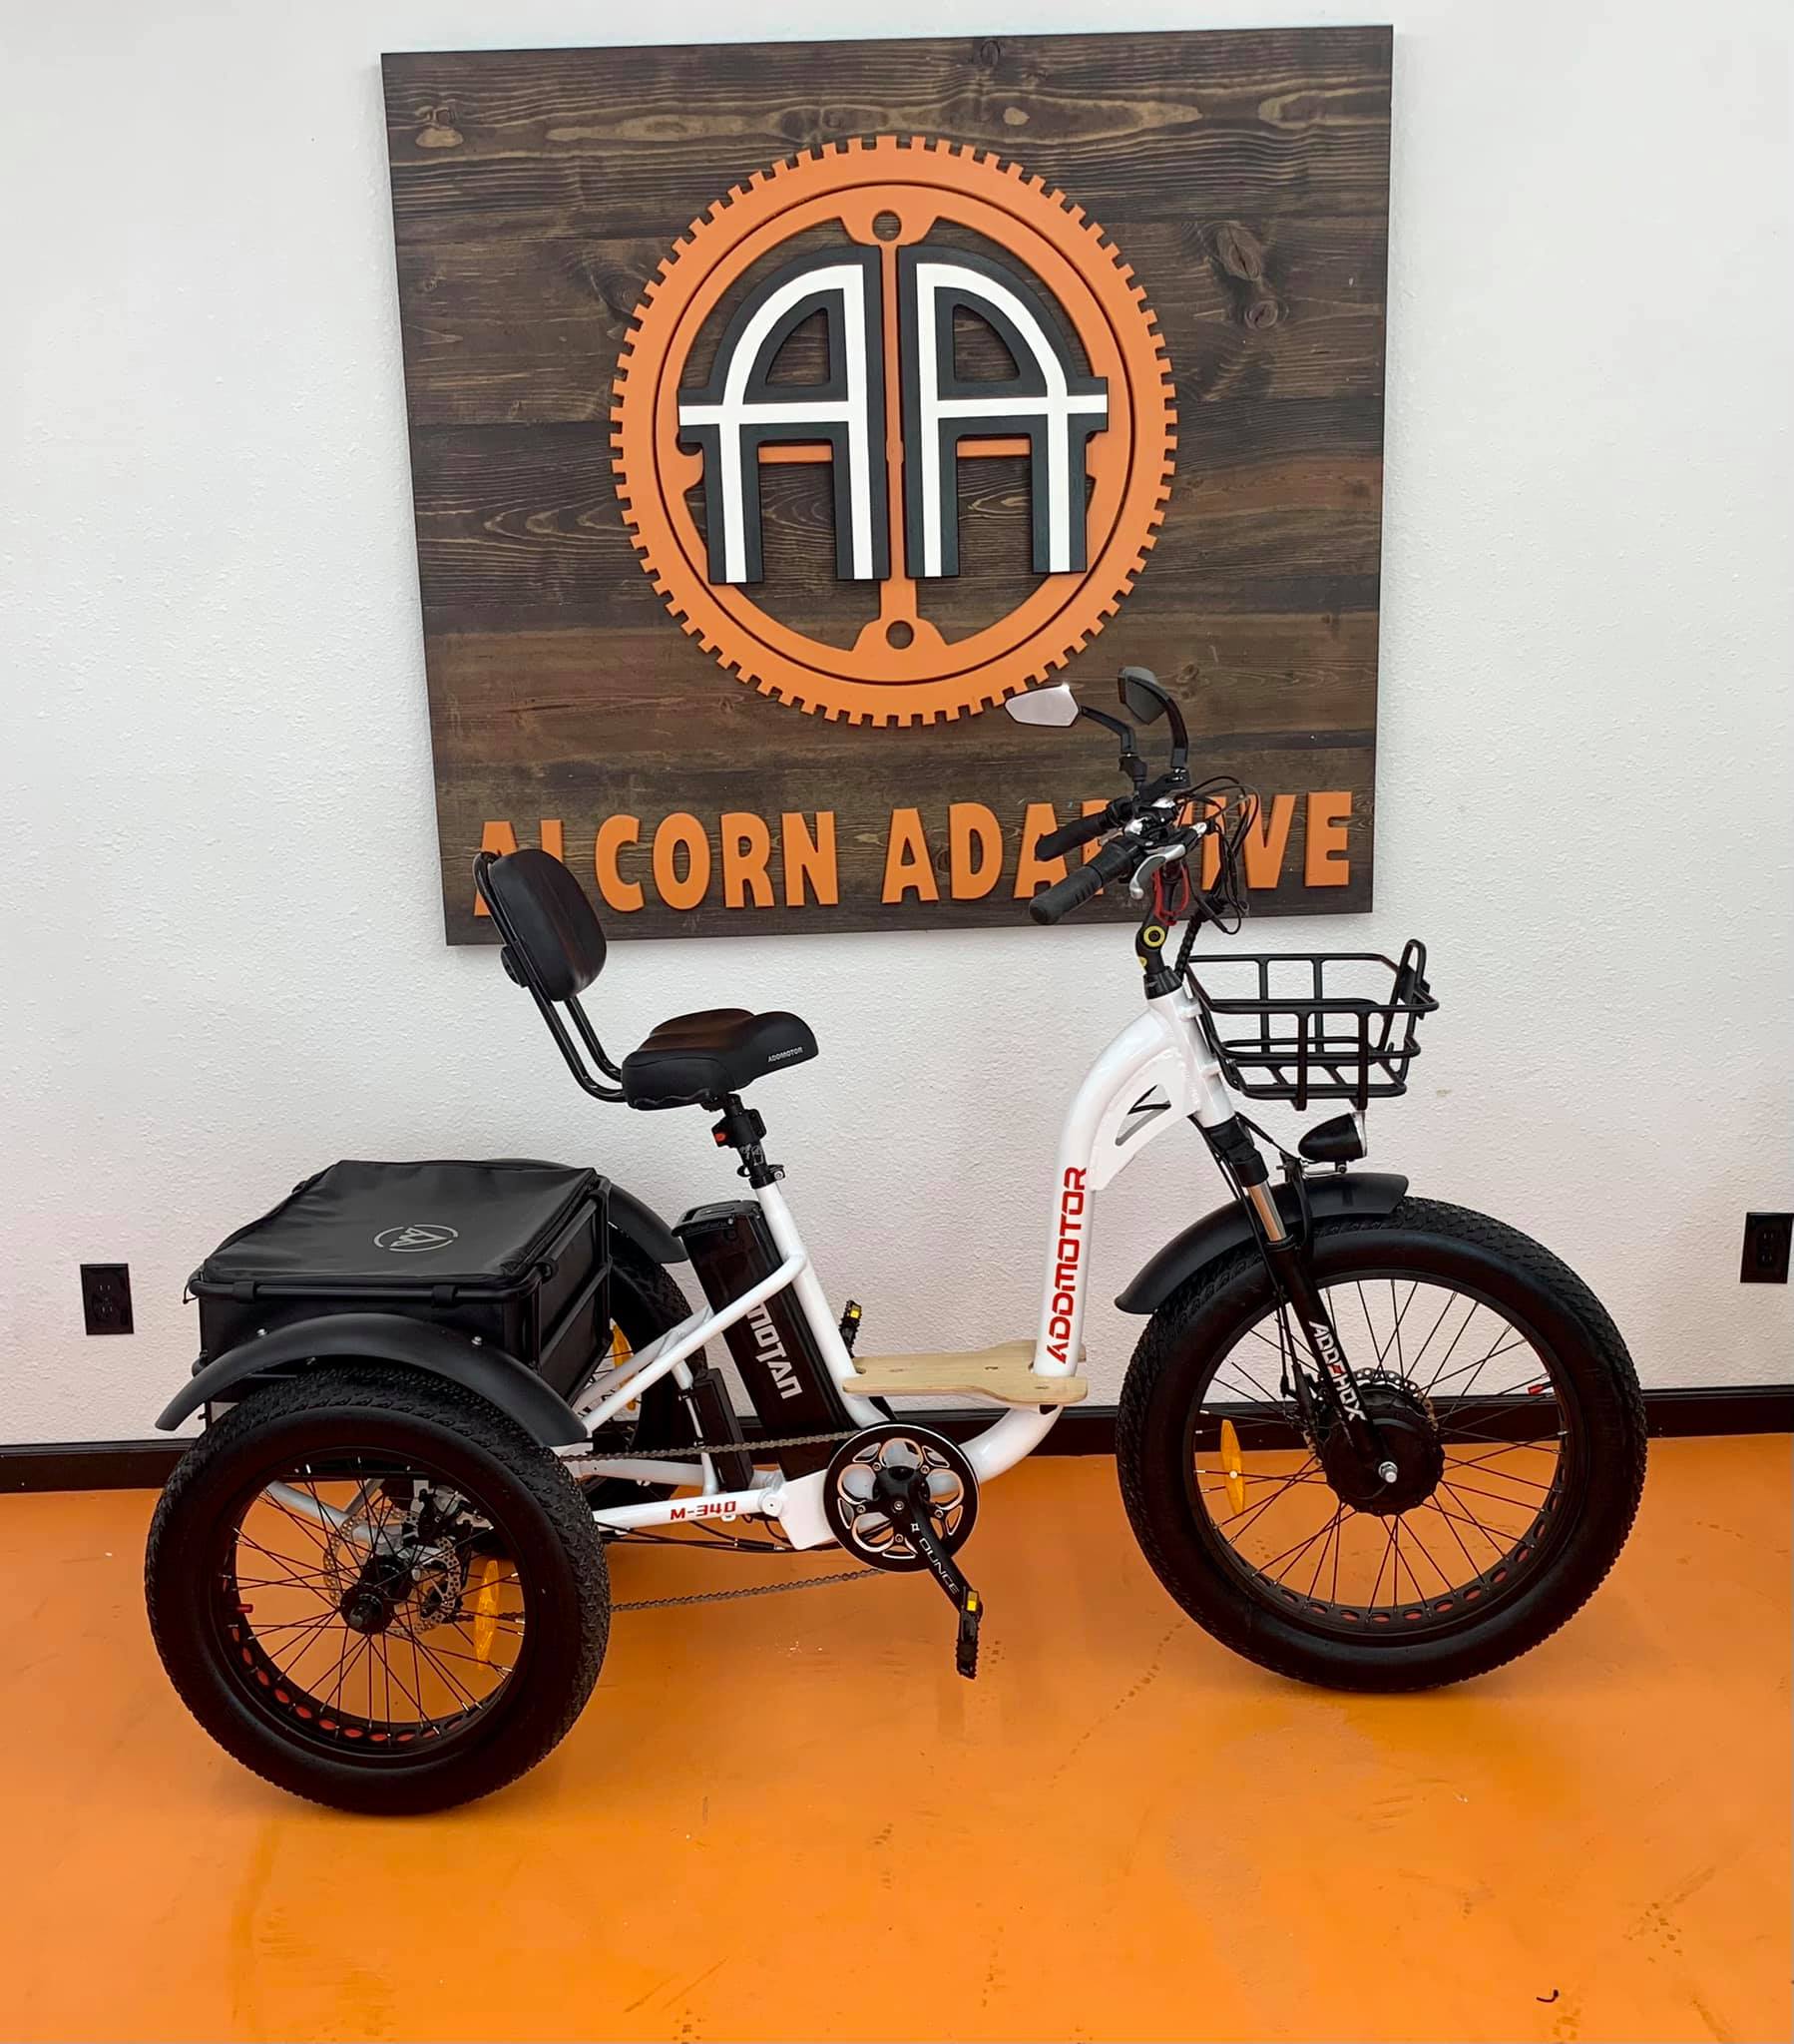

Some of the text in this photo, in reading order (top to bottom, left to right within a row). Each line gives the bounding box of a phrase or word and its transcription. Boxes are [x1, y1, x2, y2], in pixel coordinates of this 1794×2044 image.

[882, 791, 1353, 904] ADAIVE
[767, 1046, 804, 1063] ADDMOTOR
[1046, 1166, 1088, 1364] ADDMOTOR
[670, 1500, 736, 1520] M-340
